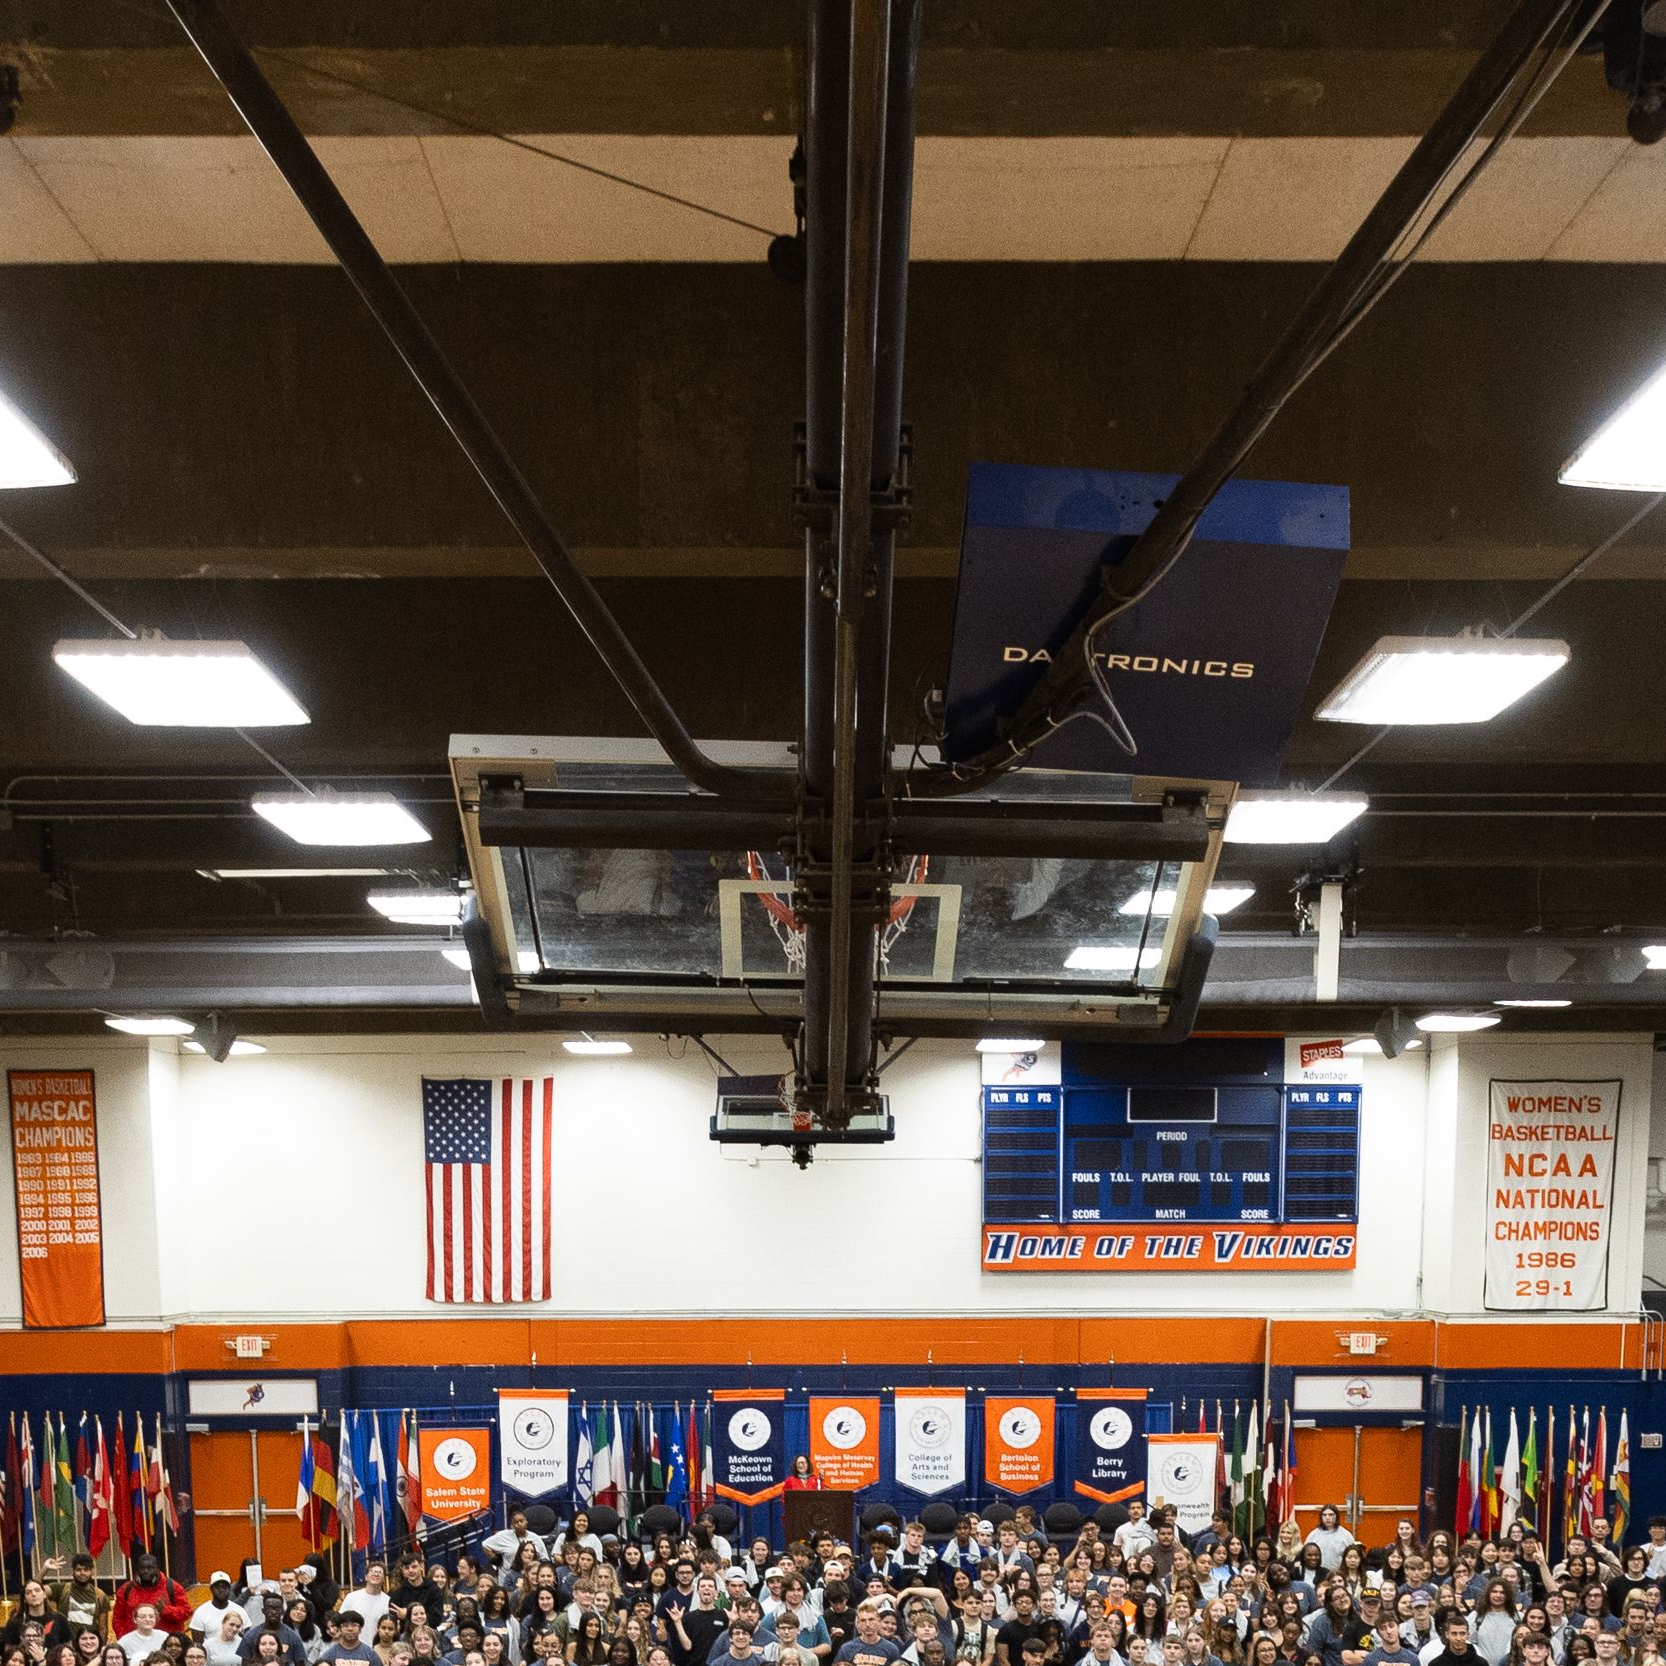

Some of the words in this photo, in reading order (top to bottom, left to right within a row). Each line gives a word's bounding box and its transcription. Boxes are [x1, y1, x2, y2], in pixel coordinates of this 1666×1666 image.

[1302, 1046, 1342, 1062] STAPLES
[1302, 1071, 1348, 1081] Advantage
[12, 1078, 43, 1095] WOMEN'S
[45, 1078, 93, 1095] BASKETBALL
[991, 1093, 1009, 1103] PLYR
[1015, 1093, 1029, 1103] FLS
[1037, 1093, 1052, 1103] PTS
[1291, 1092, 1310, 1103] PLYR
[1316, 1092, 1330, 1103] FLS
[1337, 1092, 1353, 1103] PTS
[15, 1100, 91, 1121] MASCAC
[1506, 1096, 1602, 1114] WOMEN'S
[16, 1126, 94, 1148] CHAMPIONS
[1156, 1131, 1188, 1142] PERIOD
[1491, 1124, 1614, 1142] BASKETBALL
[1503, 1153, 1599, 1178] NCAA
[1072, 1173, 1101, 1183] FOULS
[1110, 1172, 1134, 1183] T.O.L.
[1141, 1173, 1175, 1183] PLAYER
[1178, 1173, 1201, 1183] FOUL
[1209, 1172, 1233, 1183] T.O.L.
[1242, 1173, 1271, 1183] FOULS
[18, 1180, 44, 1191] 1990
[46, 1179, 71, 1190] 1991
[73, 1178, 97, 1189] 1992
[19, 1193, 45, 1205] 1994
[1495, 1188, 1605, 1209] NATIONAL
[20, 1206, 45, 1218] 1997
[48, 1206, 72, 1218] 1998
[74, 1205, 98, 1217] 1999
[1072, 1209, 1101, 1220] SCORE
[1155, 1209, 1186, 1219] MATCH
[1241, 1209, 1269, 1219] SCORE
[21, 1220, 47, 1231] 2000
[47, 1219, 71, 1230] 2001
[75, 1219, 98, 1230] 2002
[1494, 1221, 1600, 1241] CHAMPIONS
[21, 1233, 47, 1244] 2003
[49, 1233, 74, 1244] 2004
[75, 1232, 99, 1244] 2005
[987, 1232, 1085, 1263] HOME
[1093, 1236, 1135, 1258] OF
[1144, 1236, 1204, 1258] THE
[1213, 1231, 1354, 1263] VIKINGS
[1515, 1252, 1576, 1269] 1986
[1515, 1280, 1573, 1297] 29-1
[241, 1339, 258, 1352] EXIT
[1356, 1335, 1371, 1348] EXIT
[506, 1457, 562, 1468] Exploratory
[728, 1455, 773, 1464] McKeown
[908, 1454, 941, 1463] College
[942, 1454, 952, 1462] of
[1000, 1454, 1039, 1462] Bertolon
[1096, 1456, 1124, 1468] Berry
[729, 1464, 761, 1474] School
[762, 1464, 772, 1473] of
[816, 1462, 841, 1470] College
[842, 1461, 850, 1469] of
[851, 1461, 874, 1470] Health
[911, 1463, 931, 1471] Arts
[932, 1463, 950, 1471] and
[999, 1463, 1030, 1472] School
[1031, 1463, 1041, 1472] of
[513, 1469, 554, 1479] Program
[728, 1474, 773, 1483] Education
[911, 1472, 950, 1481] Sciences
[1000, 1472, 1039, 1481] Business
[1091, 1469, 1128, 1480] Library
[830, 1477, 860, 1485] Services
[425, 1488, 458, 1498] Salem
[459, 1486, 486, 1497] State
[431, 1498, 482, 1509] University
[1179, 1511, 1210, 1520] Program
